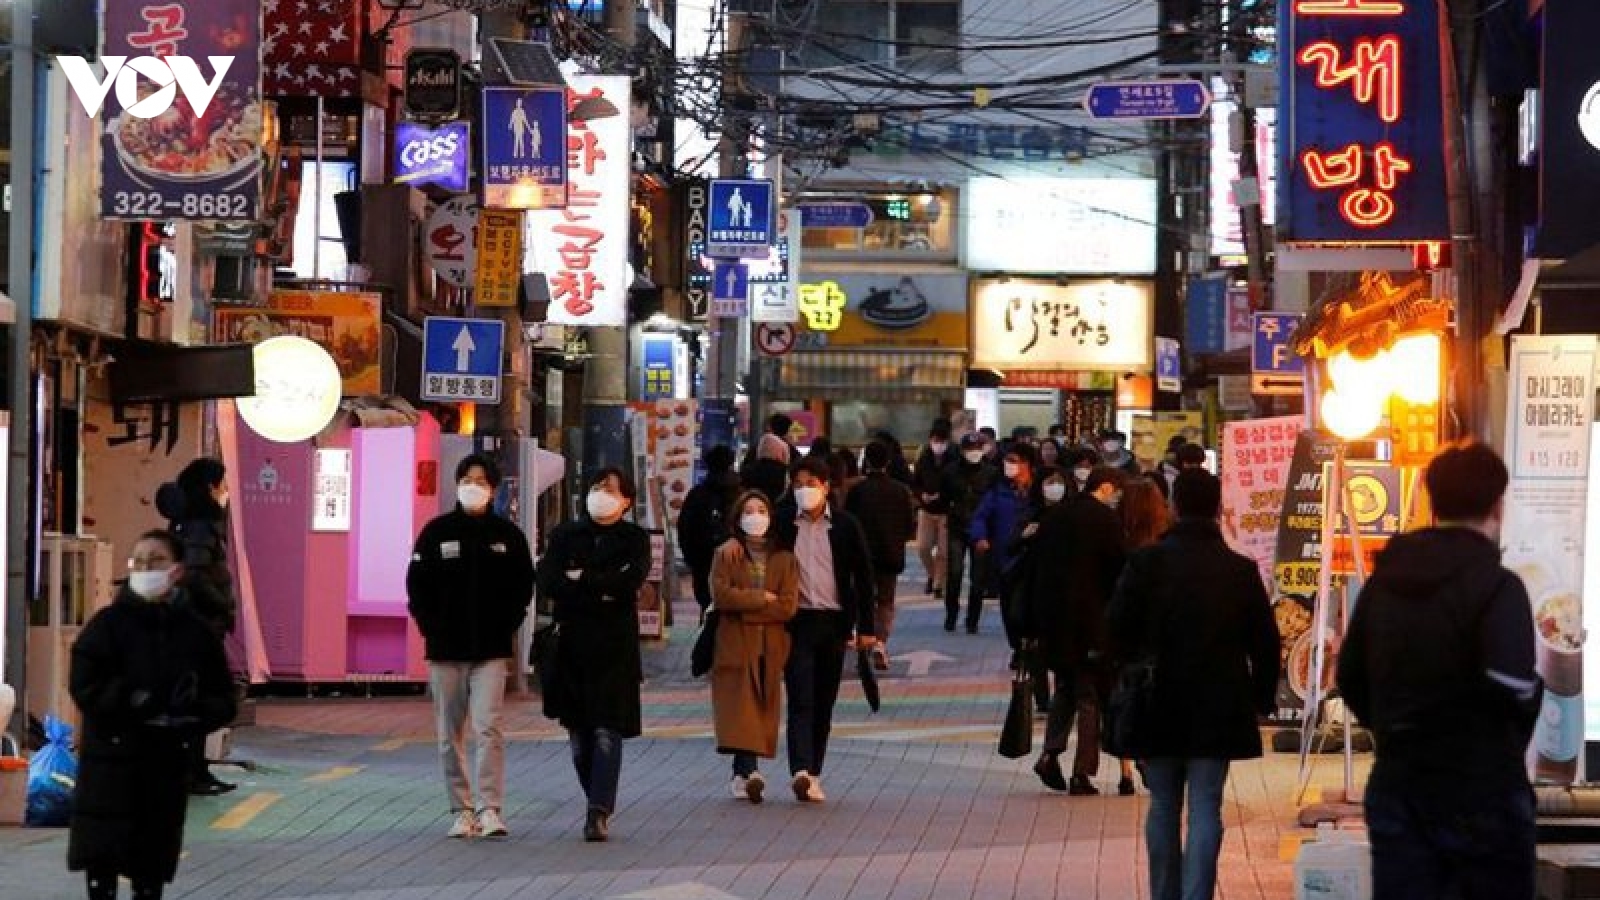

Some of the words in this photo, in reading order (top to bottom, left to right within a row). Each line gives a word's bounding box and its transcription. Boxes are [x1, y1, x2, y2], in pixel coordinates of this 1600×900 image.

[402, 132, 458, 167] Cass
[113, 191, 248, 217] 322-8682
[429, 375, 494, 397] 일방통행
